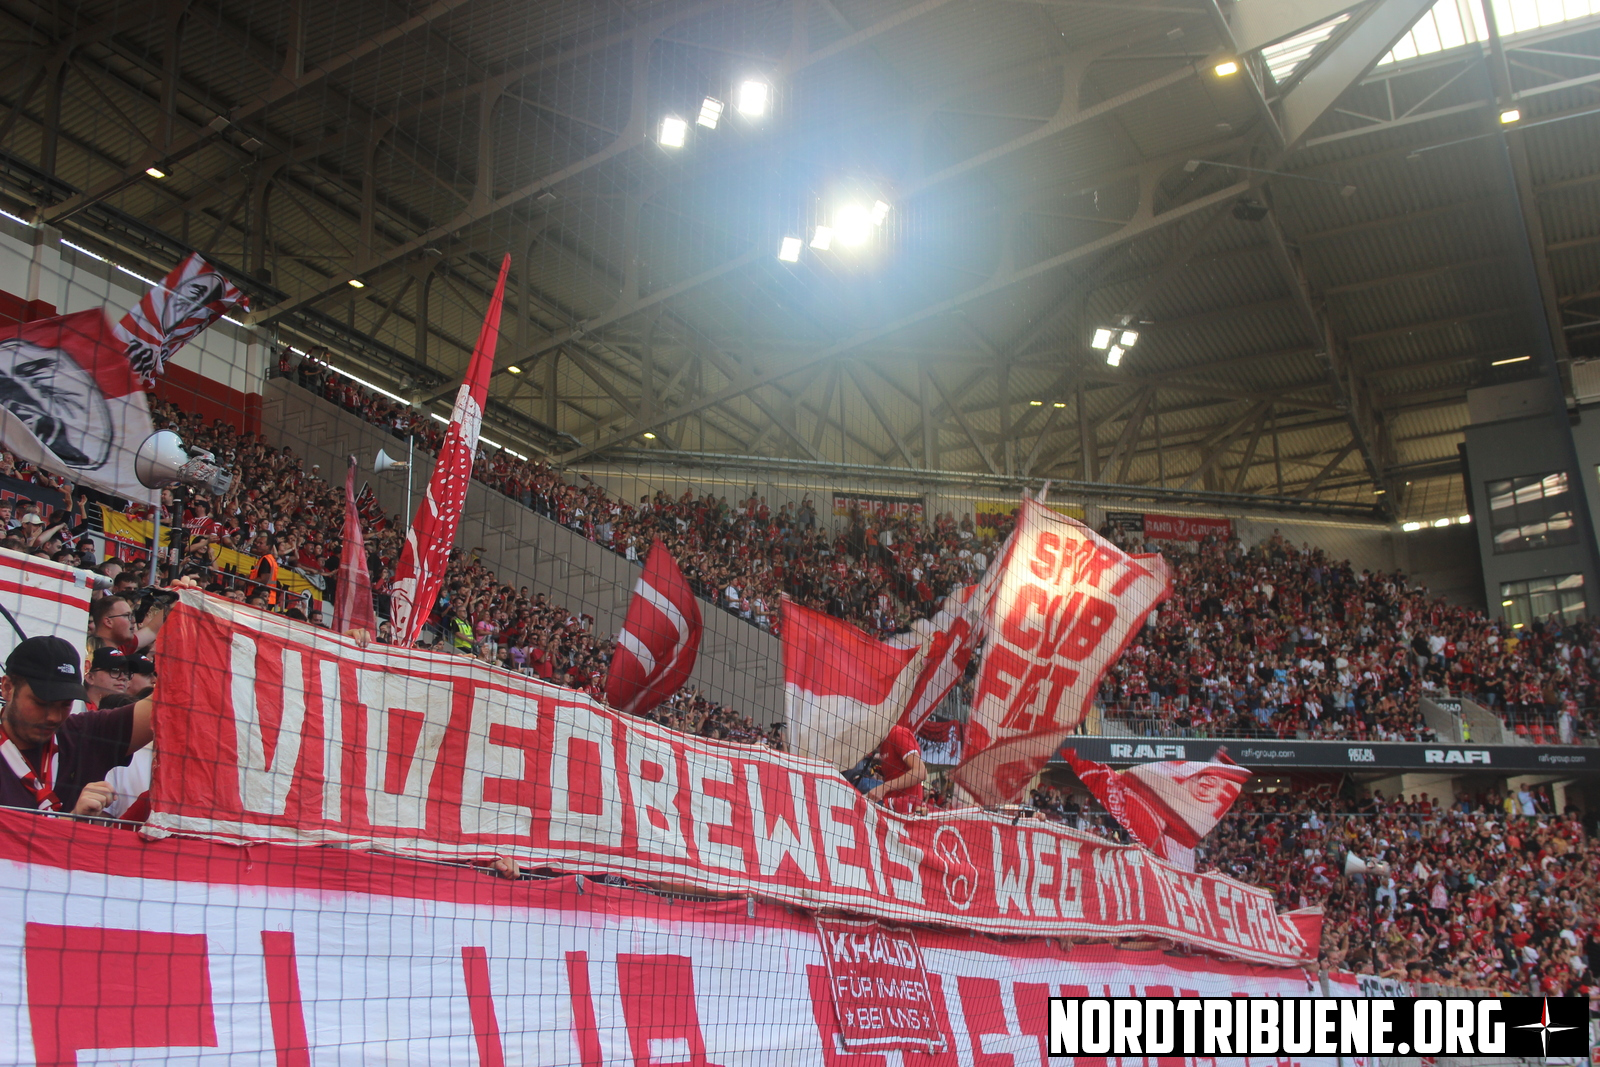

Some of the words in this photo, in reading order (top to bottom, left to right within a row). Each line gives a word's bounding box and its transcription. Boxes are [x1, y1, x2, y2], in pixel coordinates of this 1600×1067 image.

[1110, 744, 1186, 759] RAFI
[1348, 748, 1364, 756] GET
[1365, 748, 1374, 756] IN
[1349, 755, 1376, 763] TOUCH
[1425, 750, 1492, 764] RAFI
[1538, 754, 1586, 764] rafi-group.com
[992, 826, 1083, 919] WEG
[1092, 847, 1146, 921] MIT
[1146, 857, 1218, 938] DEM
[827, 931, 917, 970] KHALID
[836, 969, 874, 998] FÜR
[876, 977, 927, 1003] IMMER
[856, 1007, 885, 1030] BEI
[886, 1007, 921, 1031] UNS
